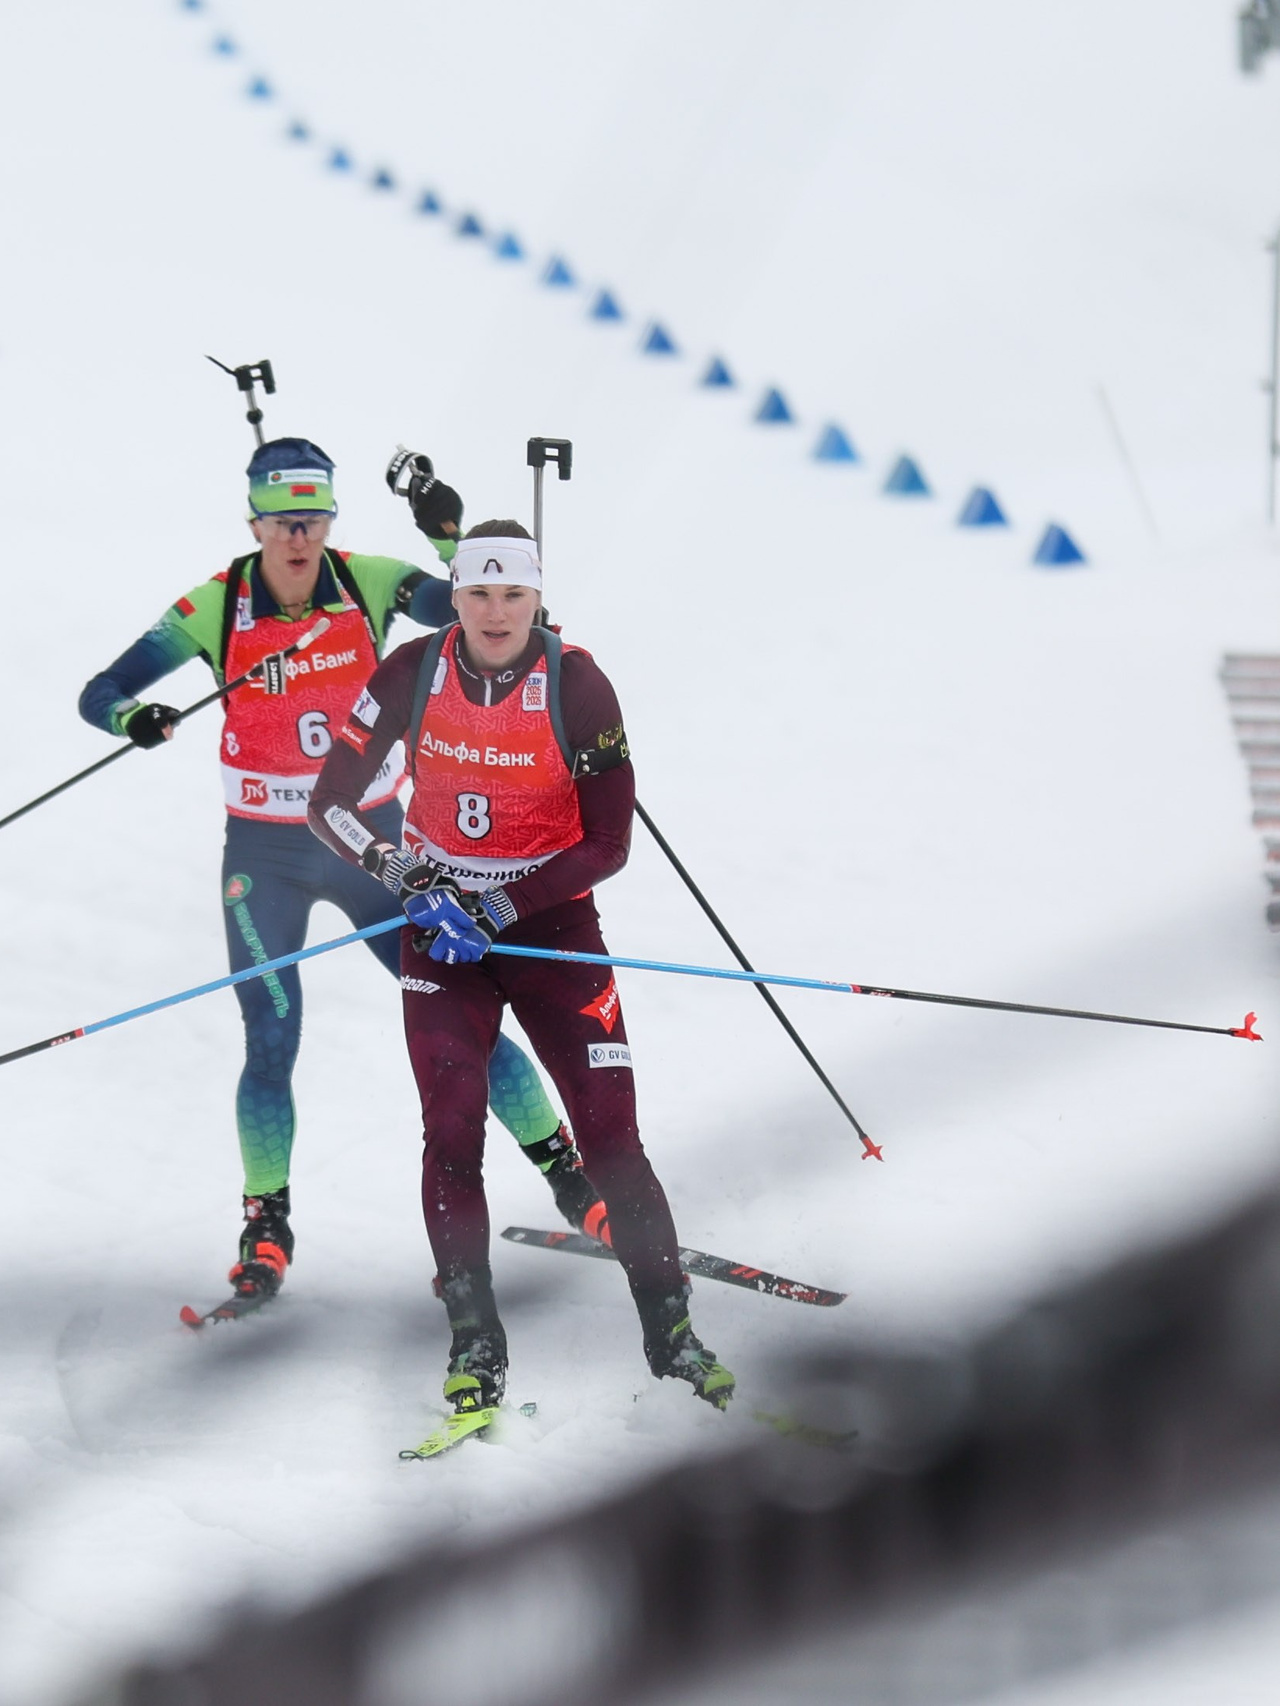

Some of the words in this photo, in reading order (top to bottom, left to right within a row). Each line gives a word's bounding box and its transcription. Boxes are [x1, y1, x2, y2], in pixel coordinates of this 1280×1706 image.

[311, 649, 358, 672] Банк
[297, 710, 333, 759] 6
[420, 731, 480, 764] Альфа
[484, 746, 536, 767] Банк
[456, 792, 492, 840] 8
[233, 901, 290, 1018] БЕЛОРУСЕФТЬ
[608, 1049, 620, 1060] GV
